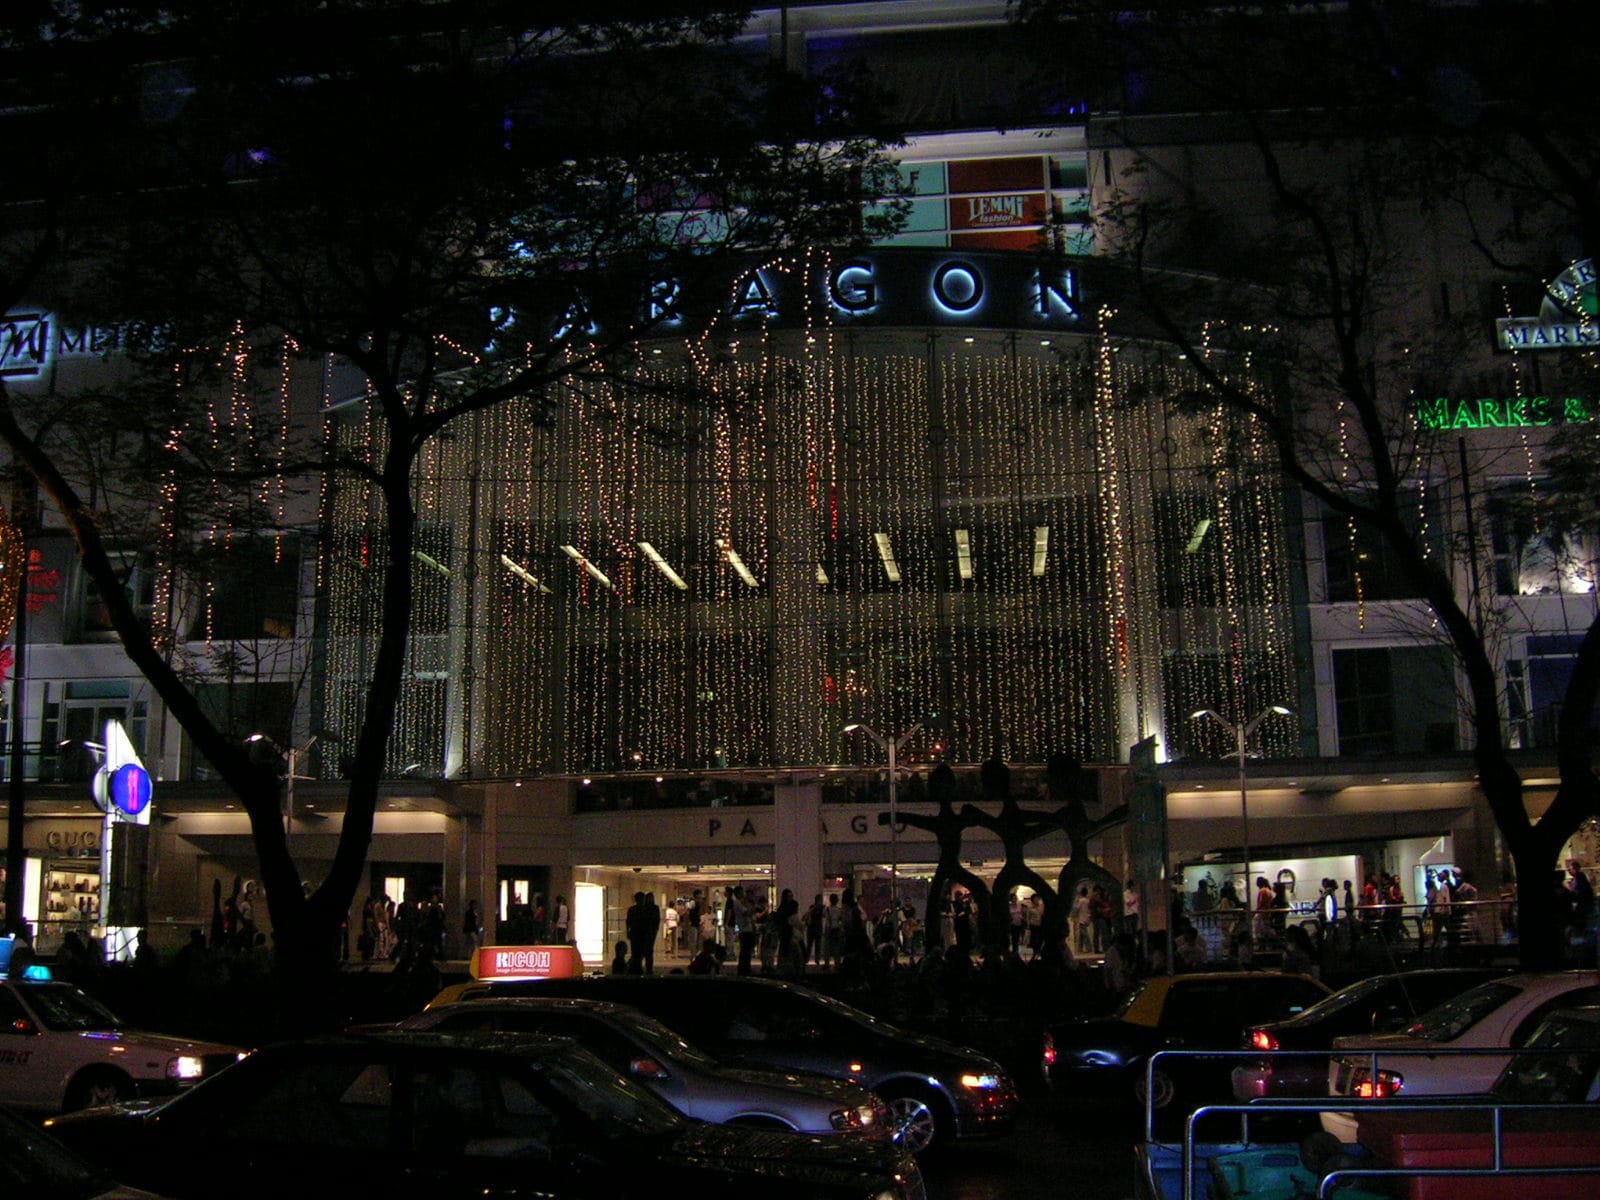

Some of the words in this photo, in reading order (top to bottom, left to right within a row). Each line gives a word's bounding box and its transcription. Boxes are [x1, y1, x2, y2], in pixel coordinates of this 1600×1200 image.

[484, 260, 1080, 352] PARAGON
[1507, 322, 1600, 344] MARK
[1417, 396, 1553, 430] MARKS
[1564, 397, 1590, 423] &
[47, 831, 101, 847] GUC
[496, 951, 550, 968] RICOH
